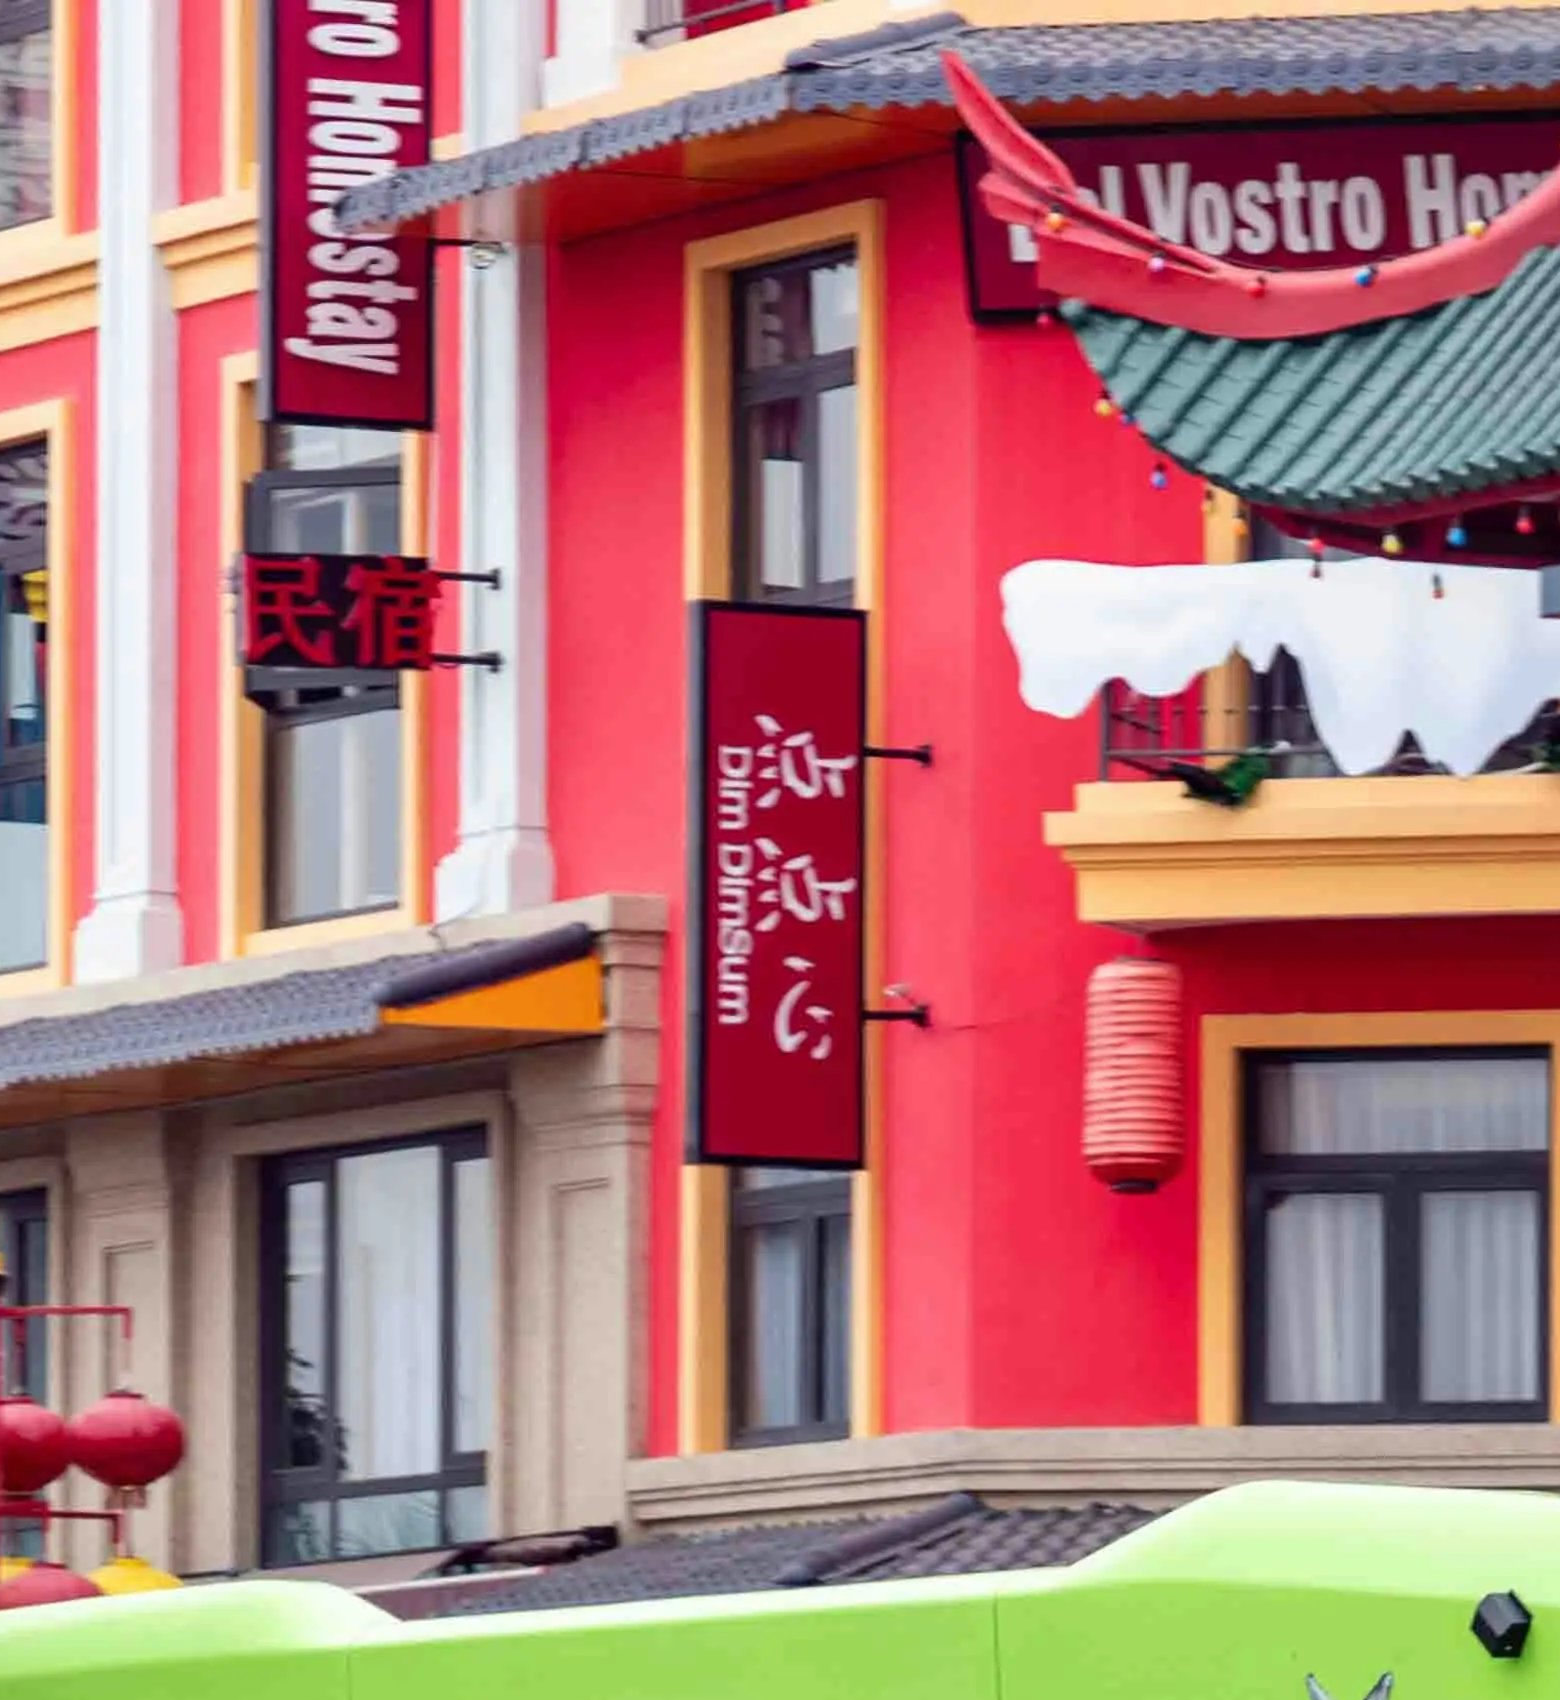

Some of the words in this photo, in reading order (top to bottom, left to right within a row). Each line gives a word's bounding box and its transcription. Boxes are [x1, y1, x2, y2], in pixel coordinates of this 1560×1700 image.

[1136, 160, 1385, 254] Vostro
[242, 554, 442, 671] 民宿
[717, 744, 754, 830] Dim
